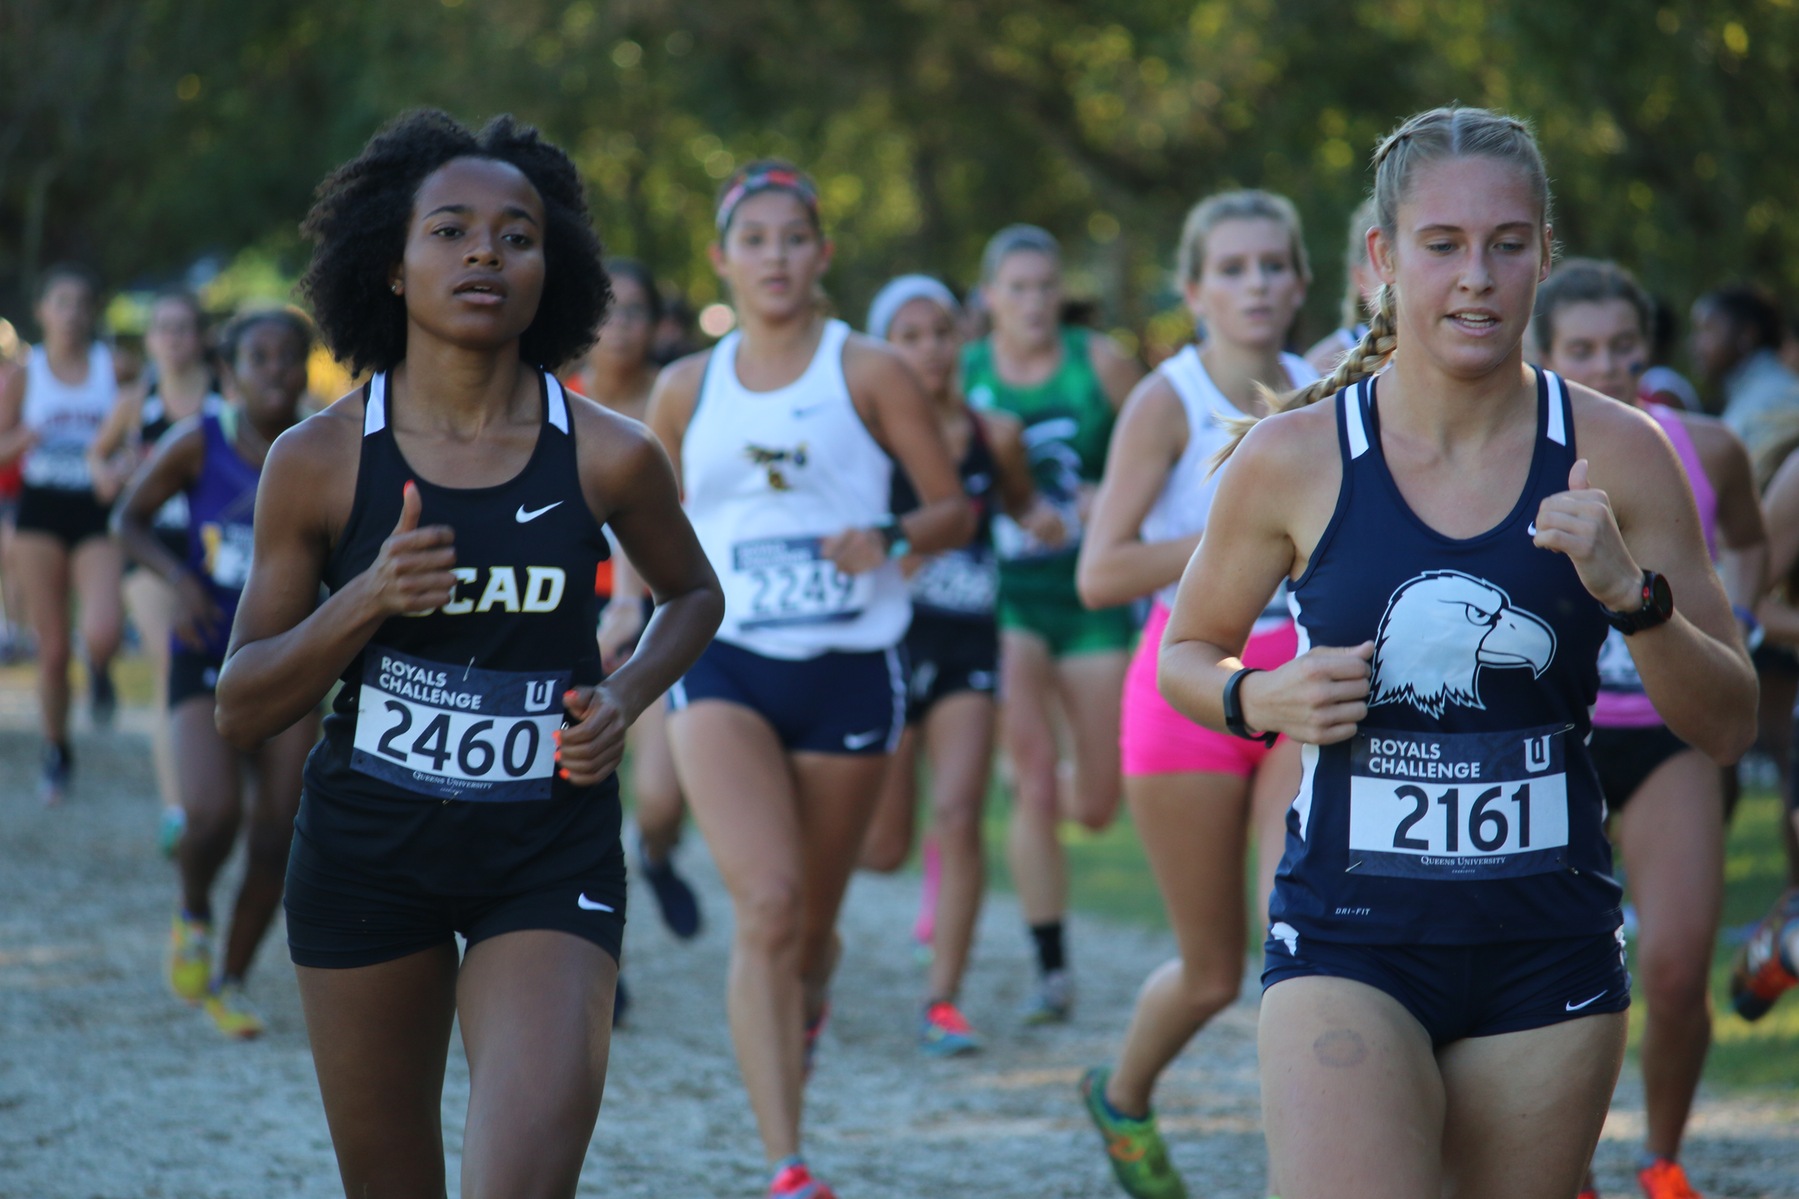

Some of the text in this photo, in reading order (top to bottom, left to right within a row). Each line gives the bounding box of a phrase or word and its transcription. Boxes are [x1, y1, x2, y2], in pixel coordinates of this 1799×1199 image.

[402, 565, 566, 617] CAD
[750, 565, 856, 615] 2249
[380, 656, 447, 686] ROYALS
[379, 674, 482, 711] CHALLENGE
[377, 699, 539, 778] 2460
[1370, 738, 1441, 760] ROYALS
[1368, 757, 1481, 779] CHALLENGE
[1392, 782, 1530, 853] 2161
[1420, 855, 1507, 867] QUEENS UNIVERSITY
[1335, 907, 1371, 916] DRI-FIT
